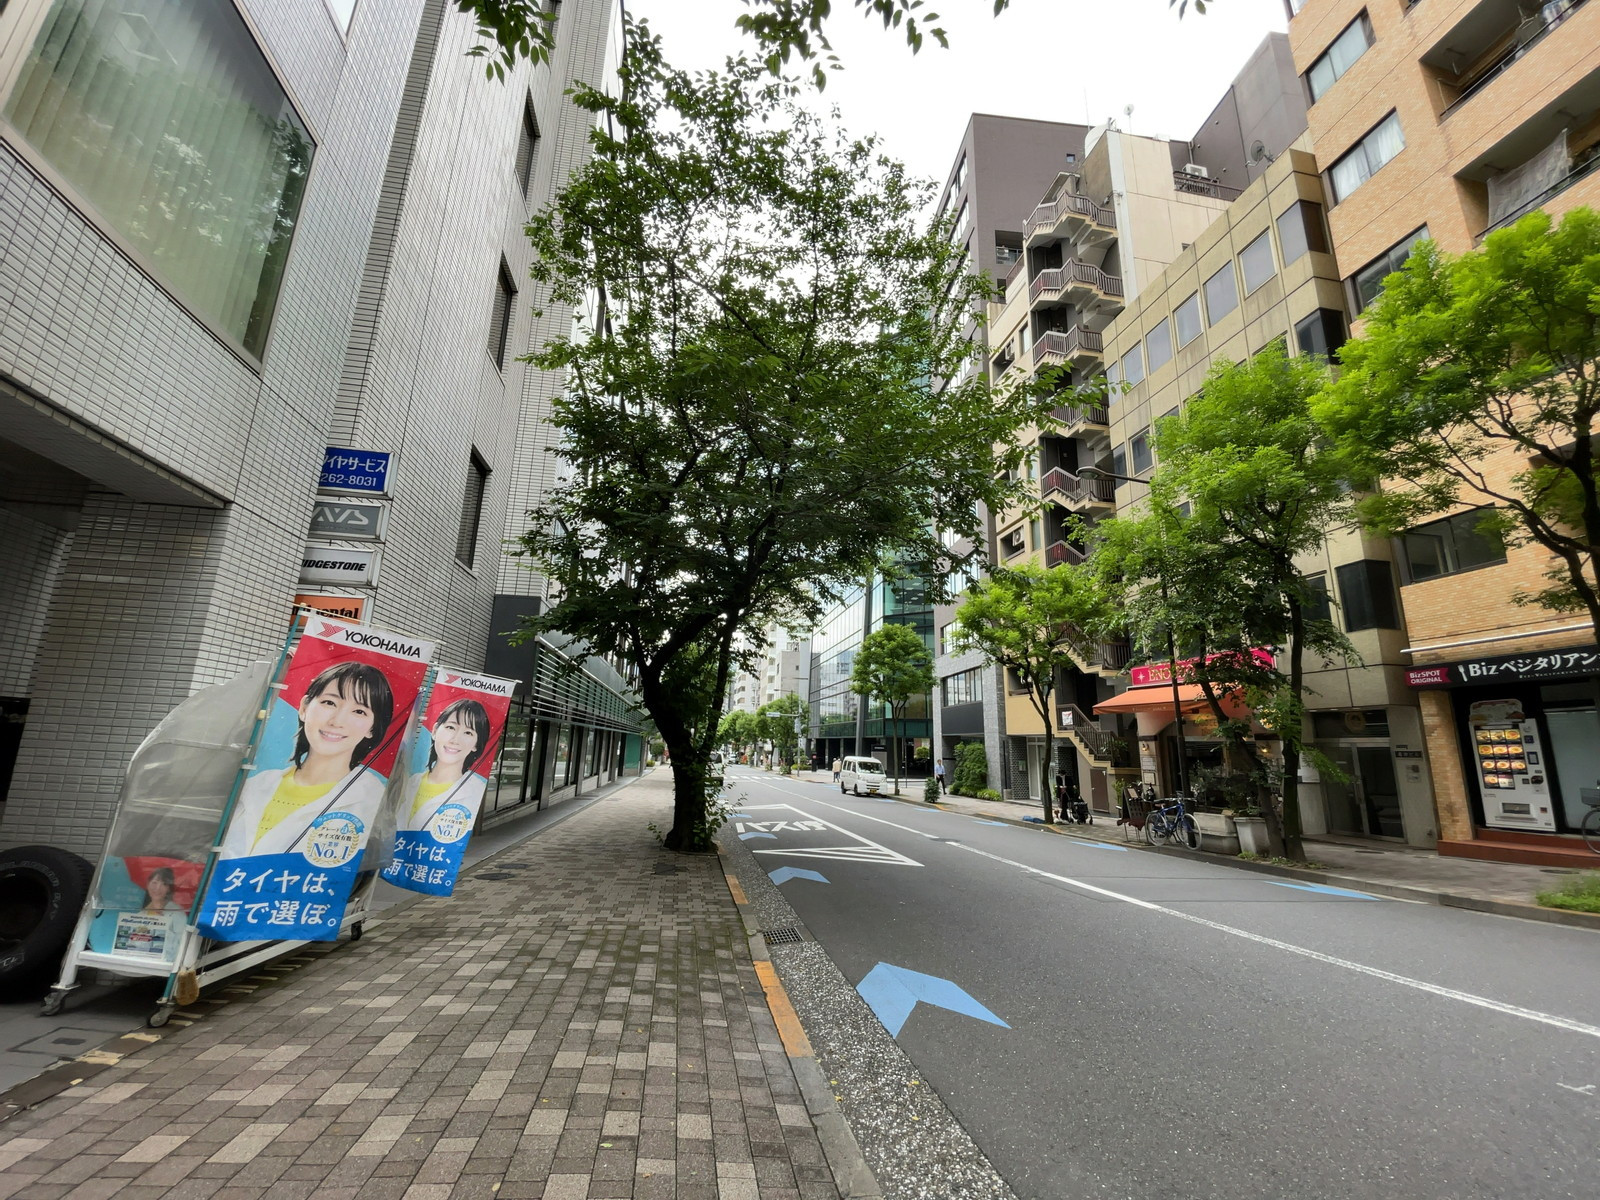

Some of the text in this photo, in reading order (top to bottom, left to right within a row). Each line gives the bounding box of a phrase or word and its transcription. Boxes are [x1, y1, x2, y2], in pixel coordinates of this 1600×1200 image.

[320, 472, 377, 487] 262-8031
[345, 629, 421, 658] YOKOHAMA
[460, 677, 507, 694] YOKOHAMA
[1410, 676, 1443, 685] ORIGINAL
[394, 837, 451, 864] タイヤは、
[223, 868, 335, 896] タイヤは、
[383, 858, 452, 887] 雨で選ぼ。
[211, 900, 337, 927] 雨で選ぼ。
